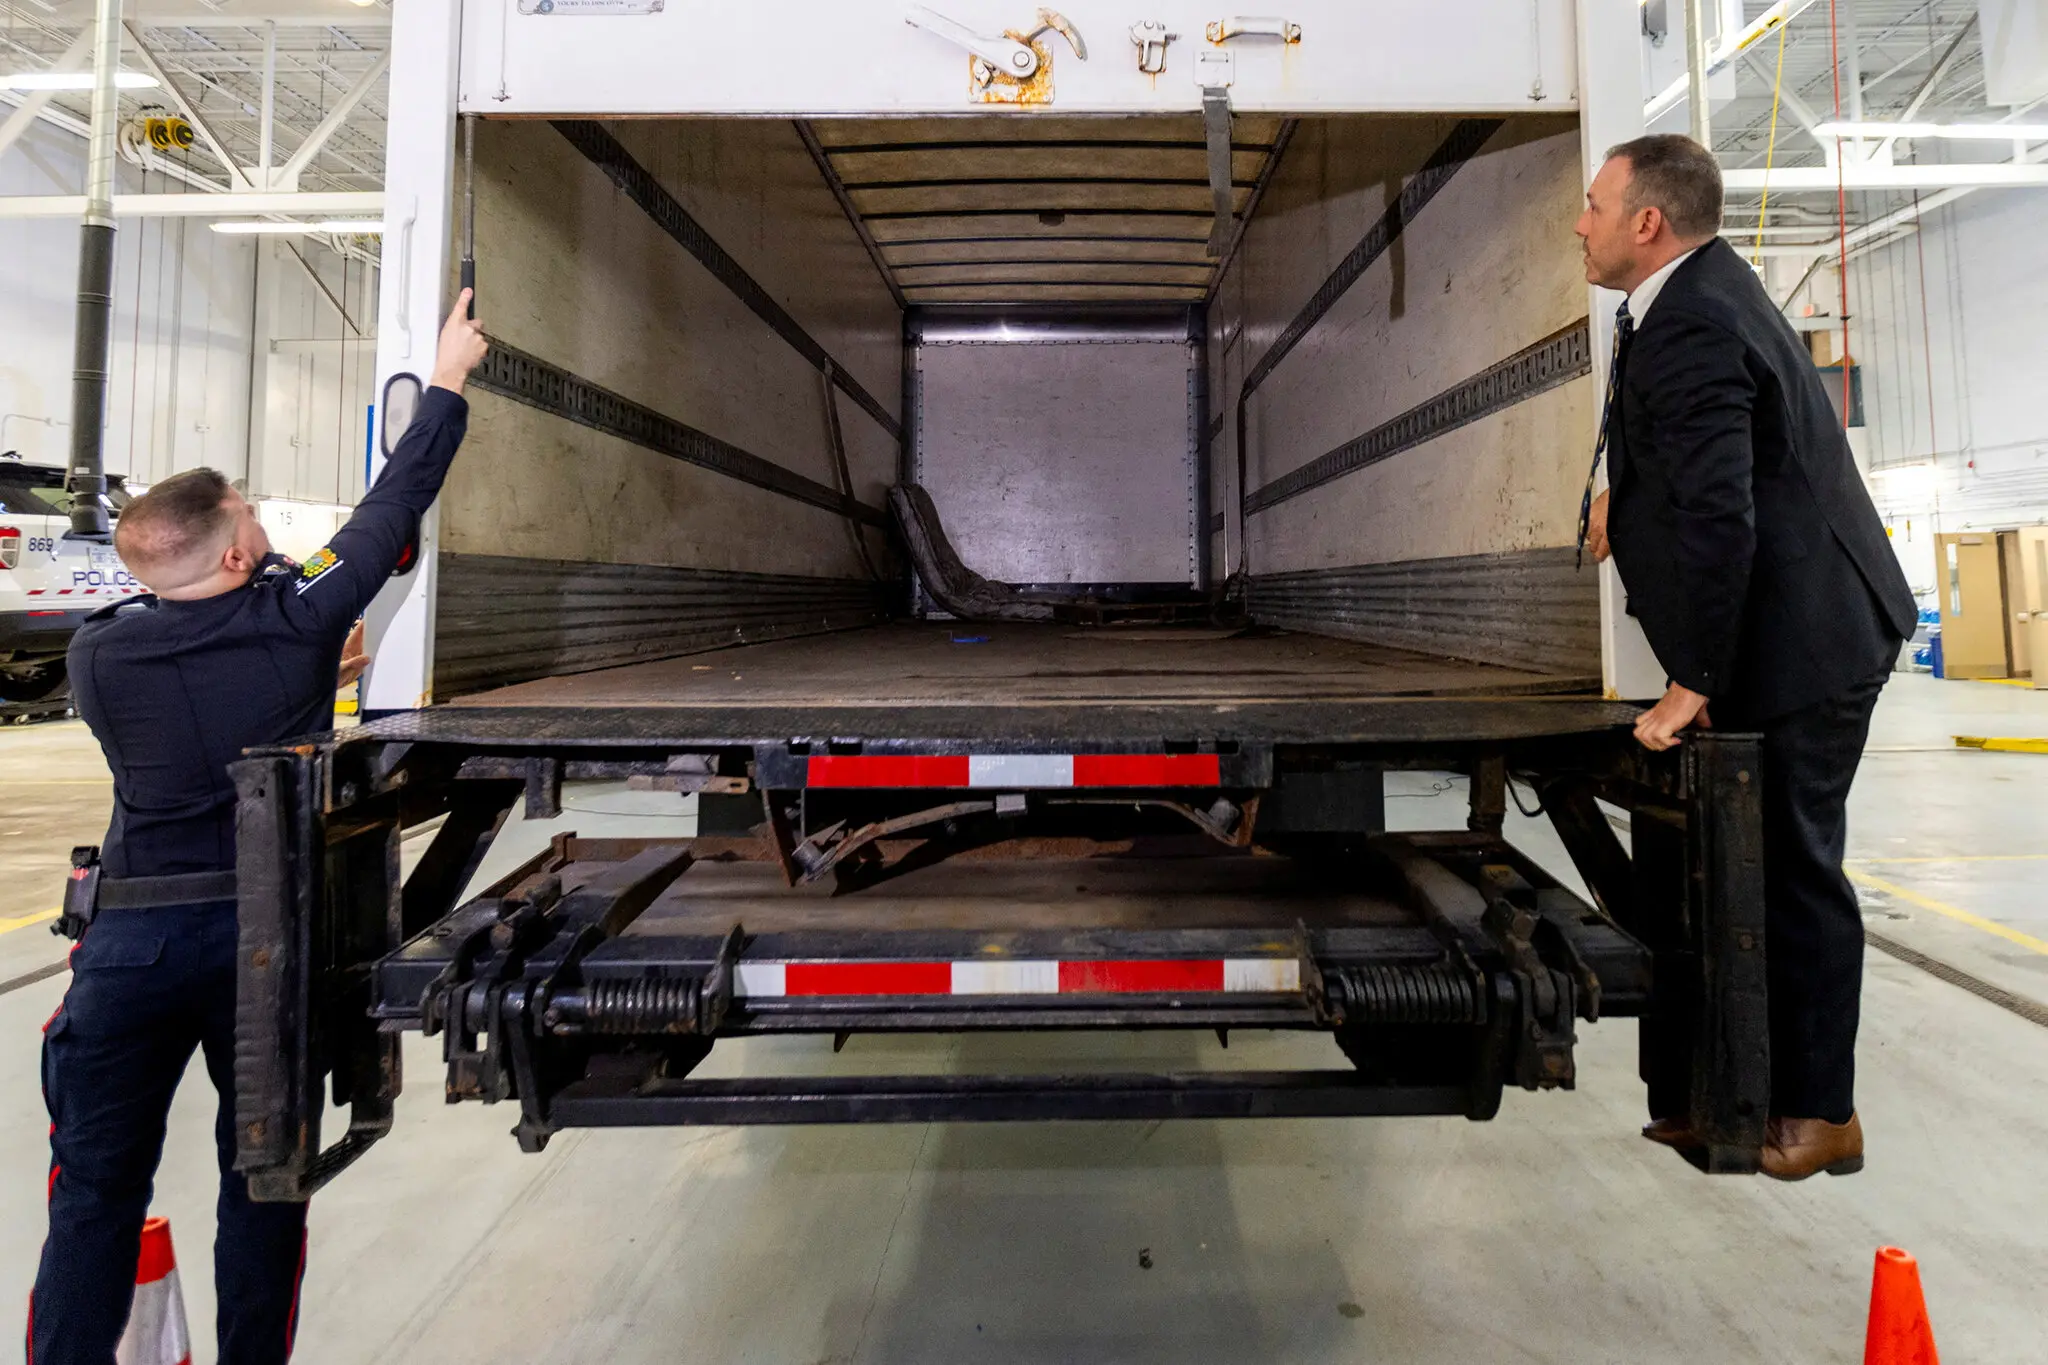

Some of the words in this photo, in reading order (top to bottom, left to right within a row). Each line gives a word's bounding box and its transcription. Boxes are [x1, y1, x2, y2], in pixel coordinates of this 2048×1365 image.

[280, 511, 293, 526] 15
[28, 537, 54, 552] 869
[73, 571, 138, 586] POLICE
